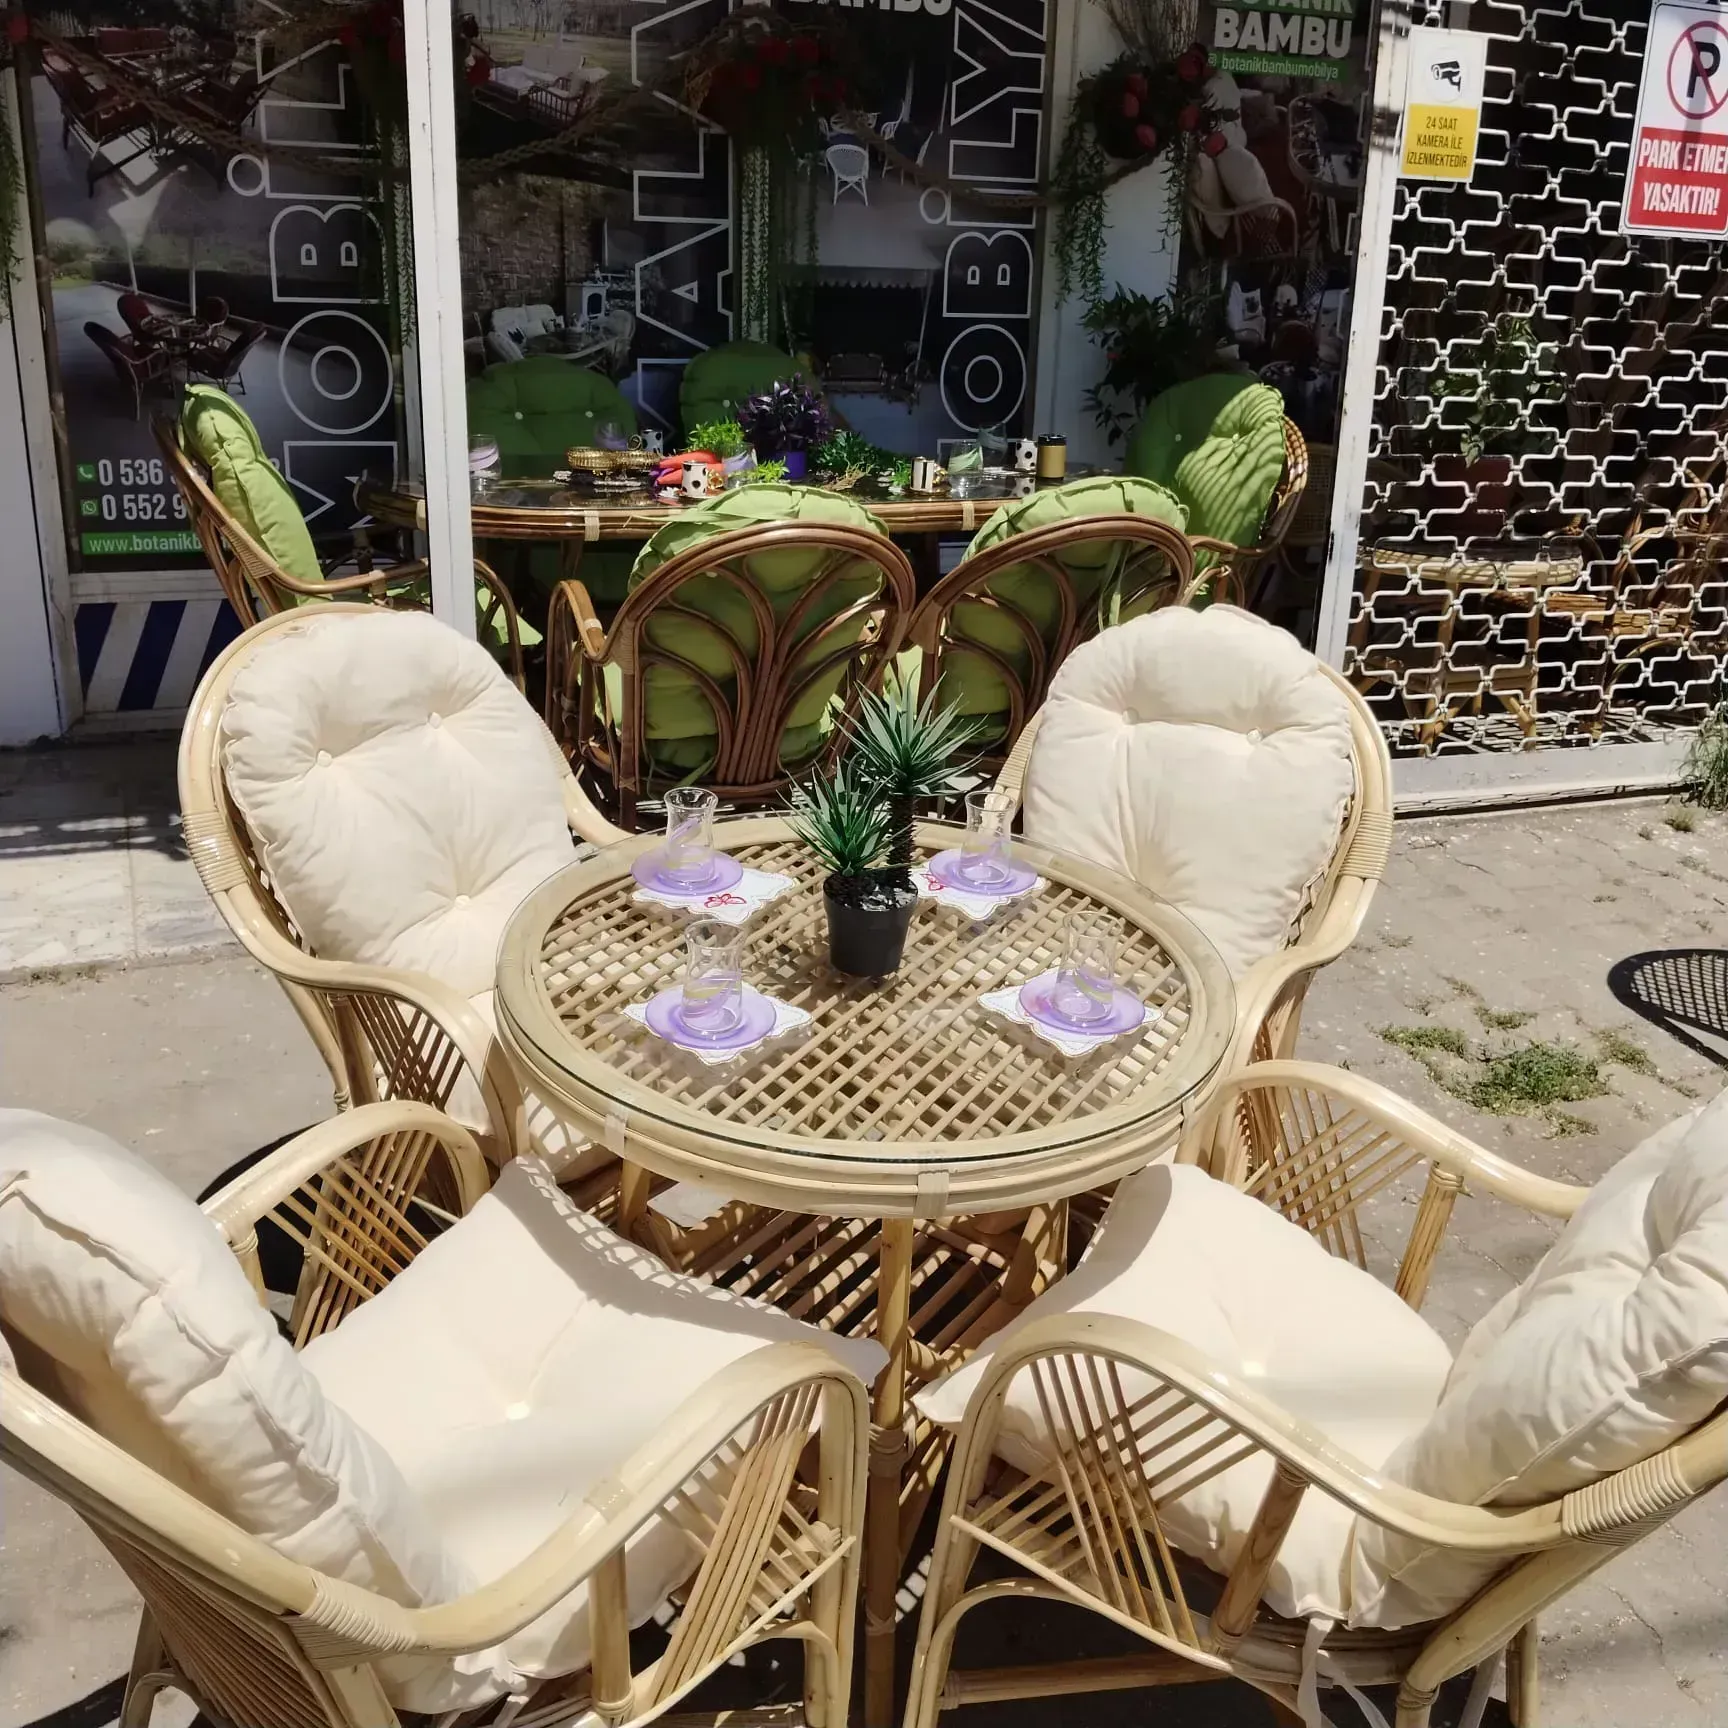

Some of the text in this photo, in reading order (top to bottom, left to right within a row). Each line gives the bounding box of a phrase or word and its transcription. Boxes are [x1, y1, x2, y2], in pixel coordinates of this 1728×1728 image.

[1214, 8, 1352, 58] BAMBU
[1221, 55, 1338, 82] botanikbambumobilya
[1426, 116, 1458, 131] 24 SAAT
[1416, 134, 1463, 150] KAMERA İLE
[1638, 138, 1728, 175] PARK ETME
[1642, 182, 1721, 216] YASAKTIR!
[98, 459, 114, 486] 0
[119, 458, 163, 486] 536
[102, 494, 117, 520] 0
[123, 493, 167, 520] 552
[89, 533, 201, 552] www.botanikb
